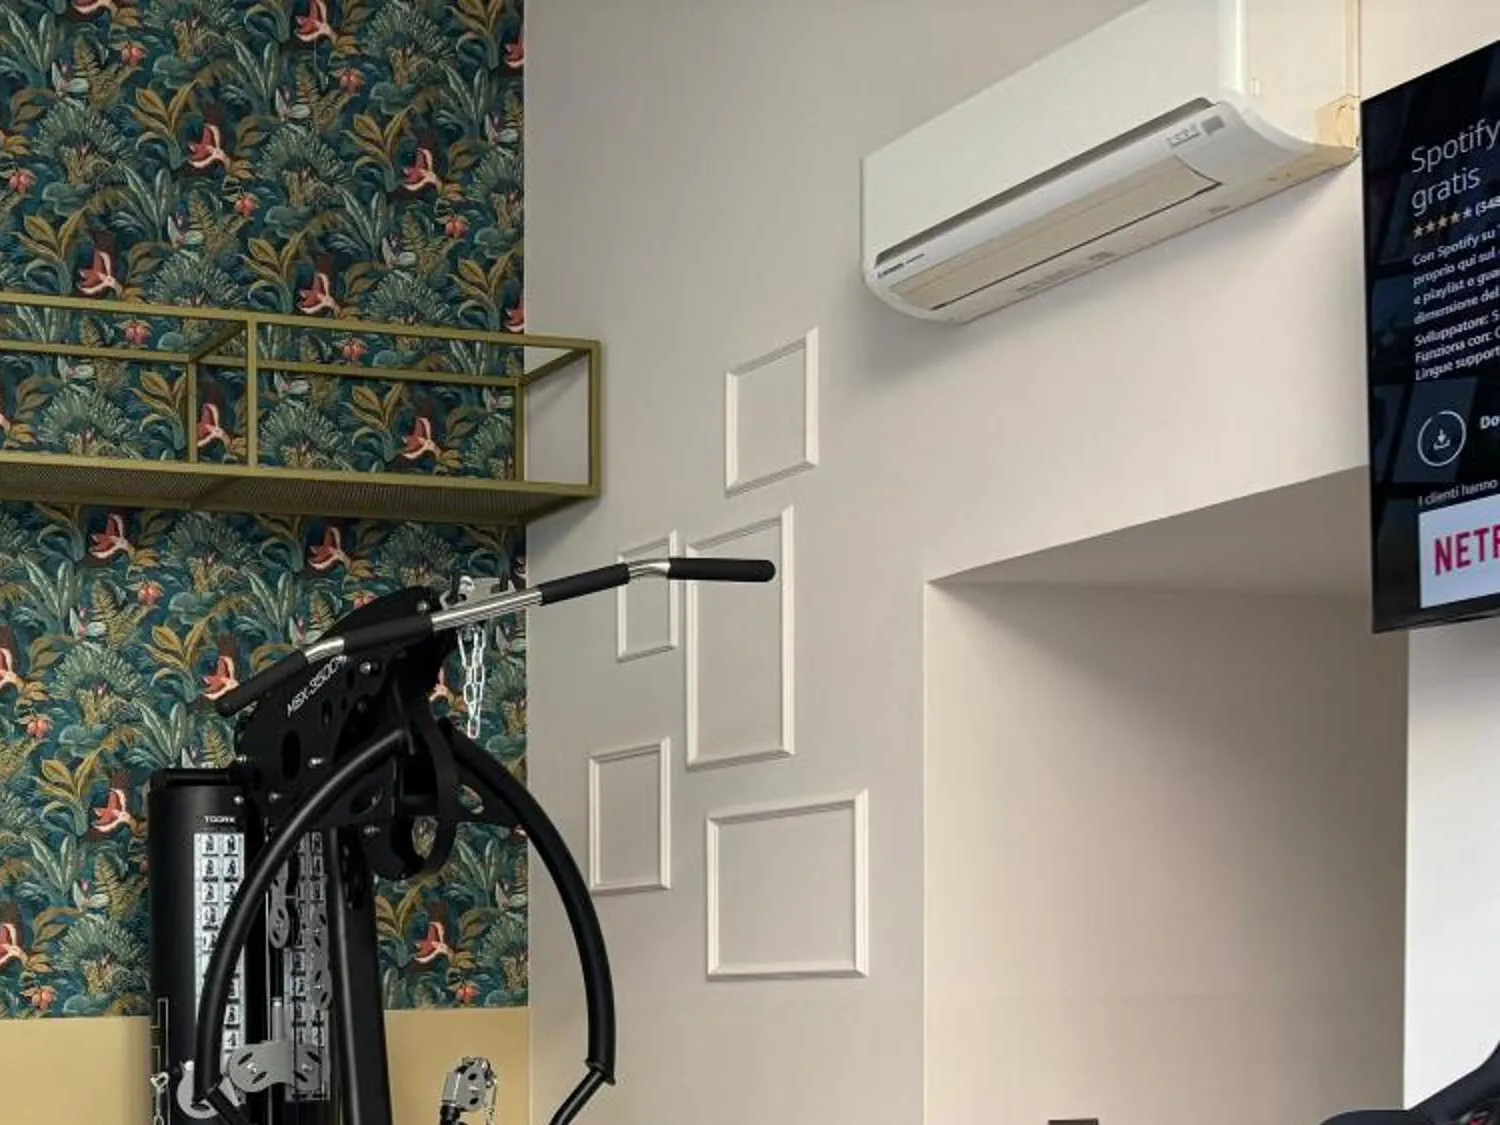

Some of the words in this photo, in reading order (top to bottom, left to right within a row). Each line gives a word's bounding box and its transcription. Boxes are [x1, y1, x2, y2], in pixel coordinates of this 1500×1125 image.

[1411, 118, 1500, 173] Spotify
[1411, 167, 1481, 217] gratis
[1412, 251, 1435, 266] Con
[1437, 234, 1479, 258] Spotify
[1481, 229, 1496, 242] su
[1413, 263, 1455, 288] proprio
[1457, 253, 1477, 271] qui
[1413, 296, 1421, 305] e
[1423, 281, 1465, 305] playlist
[1413, 296, 1479, 325] dimensione
[1414, 314, 1489, 347] Sviluppatore:
[1415, 340, 1466, 364] Funziona
[1415, 361, 1453, 381] Lingue
[1425, 486, 1460, 504] clienti
[1461, 479, 1498, 496] hanno
